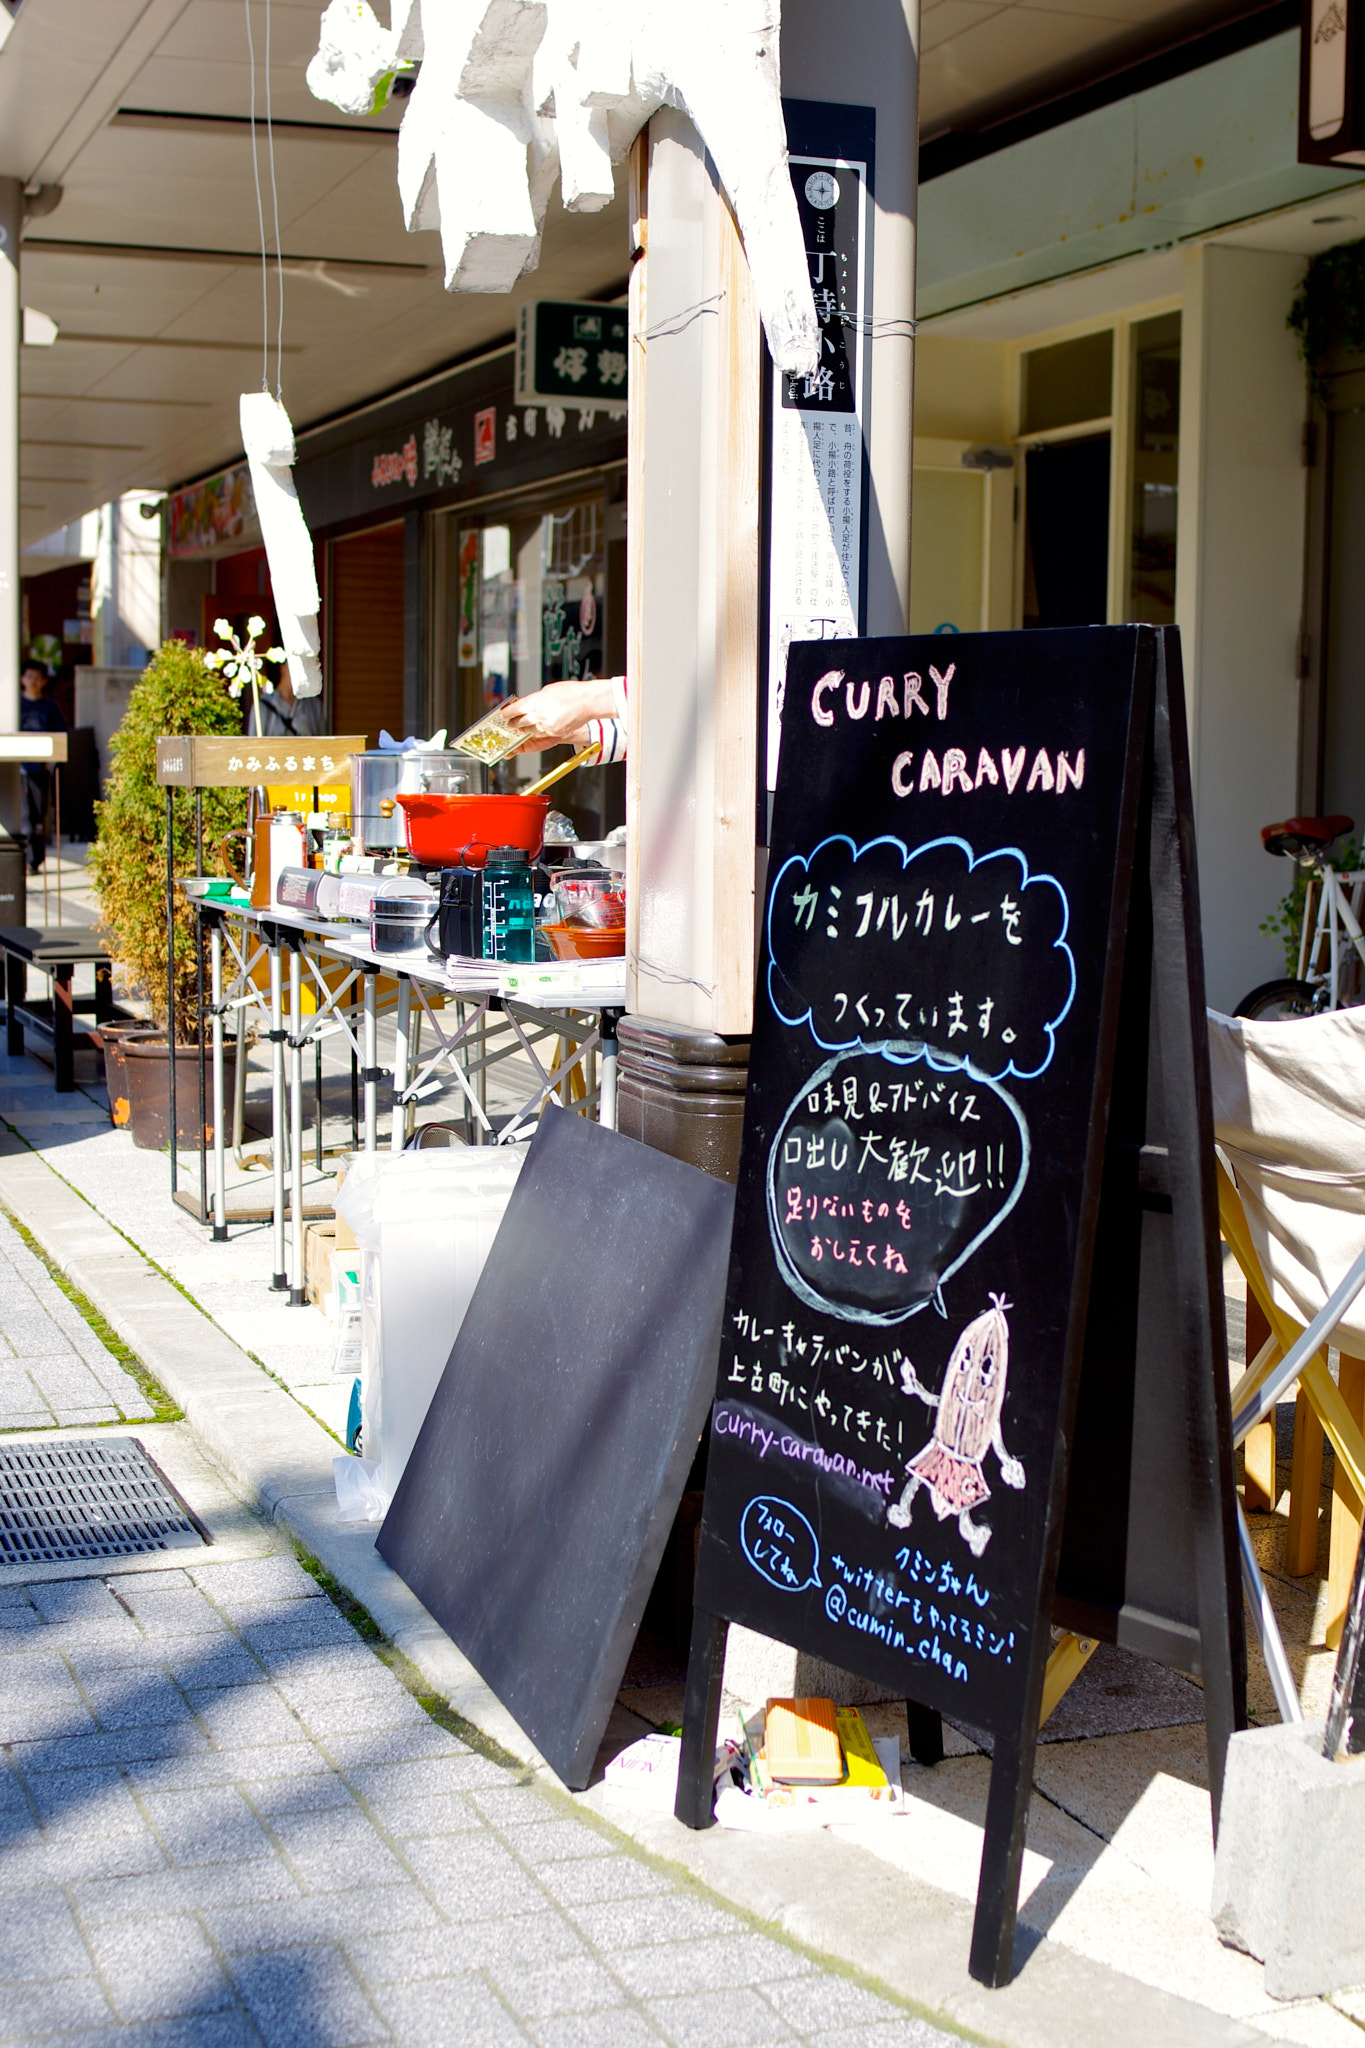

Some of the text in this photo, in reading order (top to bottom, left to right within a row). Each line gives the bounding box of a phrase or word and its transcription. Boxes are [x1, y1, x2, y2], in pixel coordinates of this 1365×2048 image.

[816, 216, 826, 243] ここは
[811, 662, 956, 727] CURRY
[228, 755, 335, 772] かみふるまち
[891, 746, 1086, 797] CARAVAN
[792, 884, 1023, 945] カミフルカレーを
[834, 990, 1017, 1043] つくっています。
[785, 1186, 912, 1230] 足りないものを
[810, 1235, 909, 1274] おしえてね
[733, 1309, 903, 1386] カレーキャラバンが
[714, 1410, 896, 1494] curry-caravan.net
[757, 1502, 796, 1544] フォロー
[753, 1538, 800, 1586] してね
[894, 1546, 991, 1607] クミンちゃん
[825, 1583, 969, 1683] @cumin_chan
